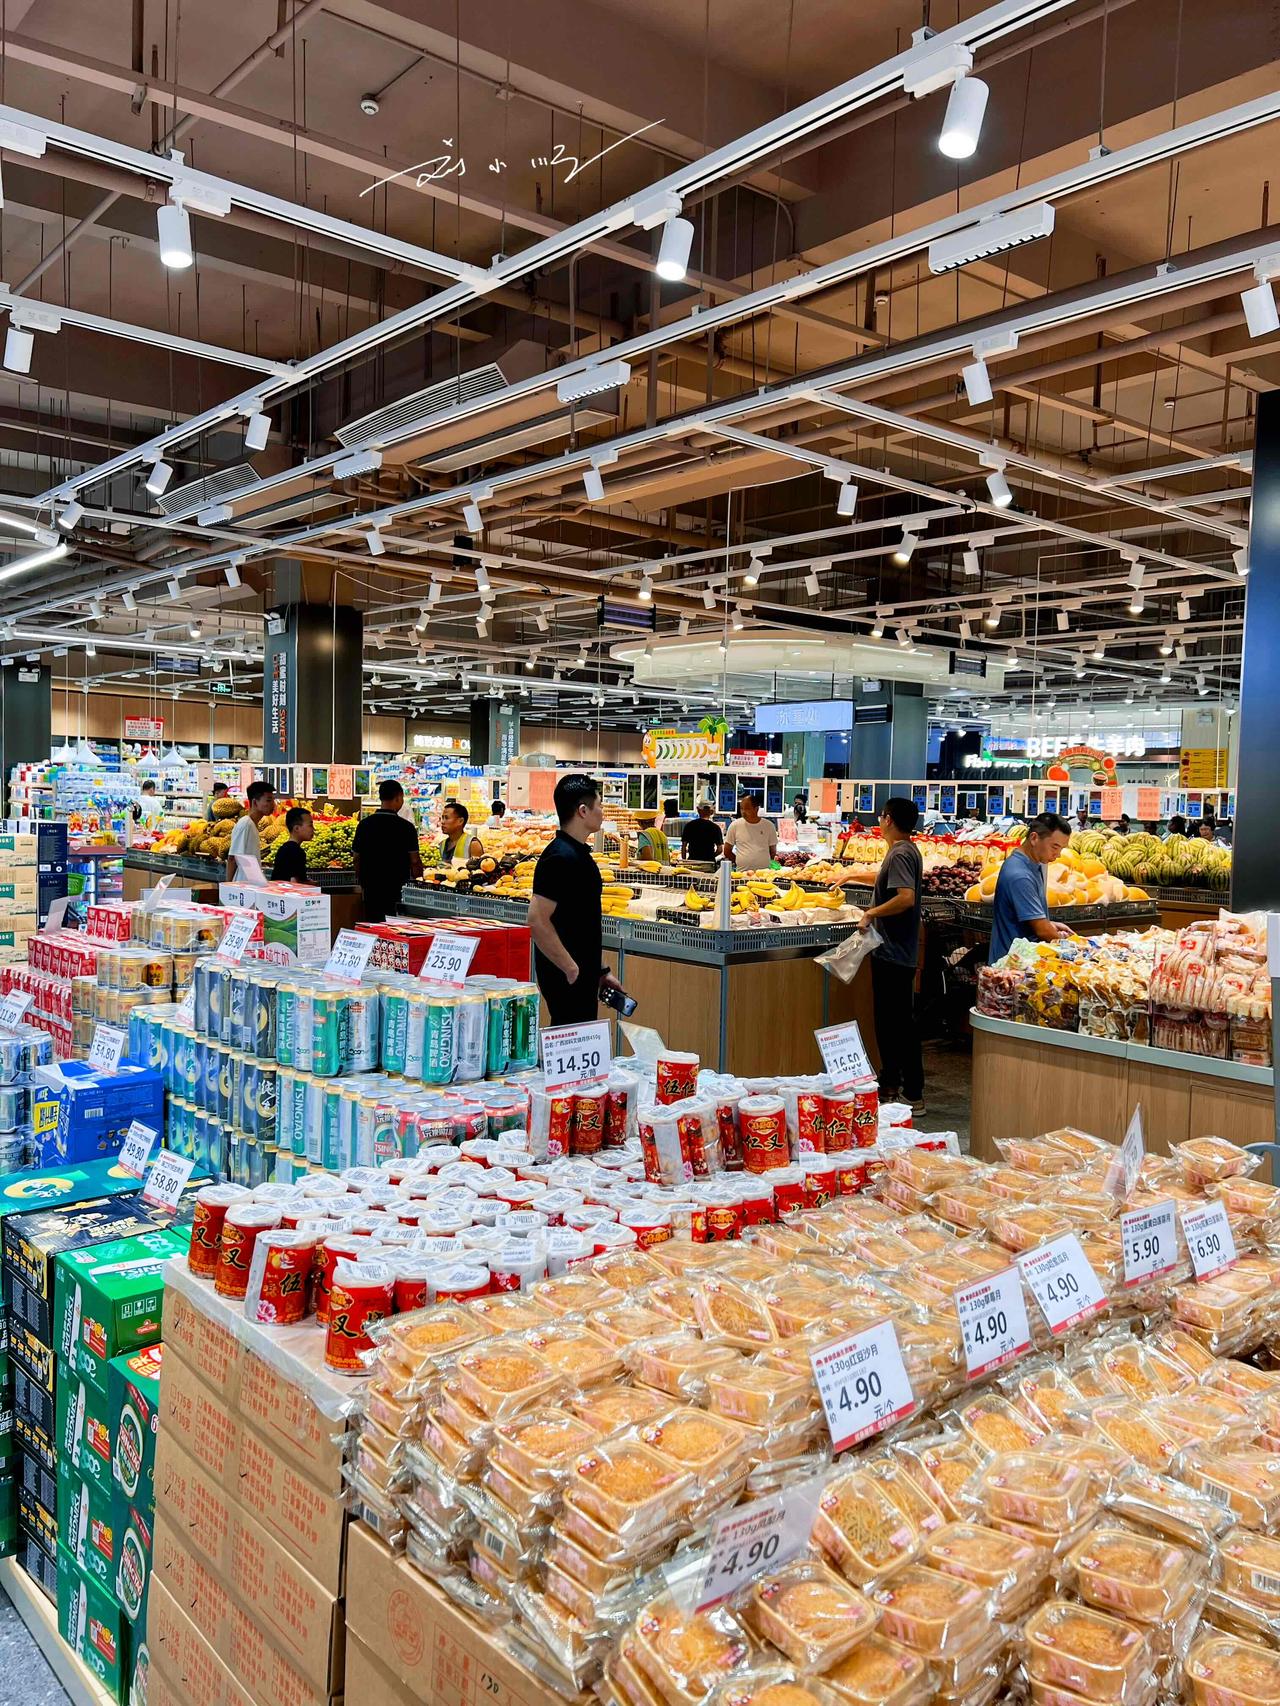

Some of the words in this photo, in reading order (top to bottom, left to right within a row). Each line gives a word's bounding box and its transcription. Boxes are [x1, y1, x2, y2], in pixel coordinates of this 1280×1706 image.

[271, 680, 279, 734] 美好生活
[279, 709, 287, 753] SWEET
[1026, 736, 1082, 758] BEEF
[1087, 733, 1146, 758] 牛羊肉
[225, 934, 244, 949] 29.90
[334, 951, 361, 968] 31.80
[431, 955, 462, 972] 25.90
[95, 1043, 116, 1061] 54.80
[439, 1012, 453, 1068] TSINGTAO
[557, 1051, 600, 1075] 14.50
[663, 1078, 696, 1097] 伍仁
[294, 1085, 305, 1141] TSINGTAO
[855, 1110, 875, 1128] 伍
[126, 1142, 145, 1161] 49.80
[152, 1172, 179, 1194] 58.80
[1132, 1235, 1160, 1263] 5.90
[1196, 1233, 1221, 1259] 6.90
[280, 1272, 302, 1296] 伍
[1047, 1272, 1079, 1304] 4.90
[969, 1288, 1002, 1312] 130g草莓月
[64, 1294, 75, 1357] TSINGTAO
[974, 1310, 1008, 1345] 4.90
[1000, 1336, 1016, 1354] 元/个
[829, 1343, 879, 1376] 130g红豆沙月
[839, 1371, 882, 1412] 4.90
[873, 1399, 895, 1420] 元/个
[67, 1396, 79, 1458] TSINGTAO
[721, 1533, 780, 1576] 4.90
